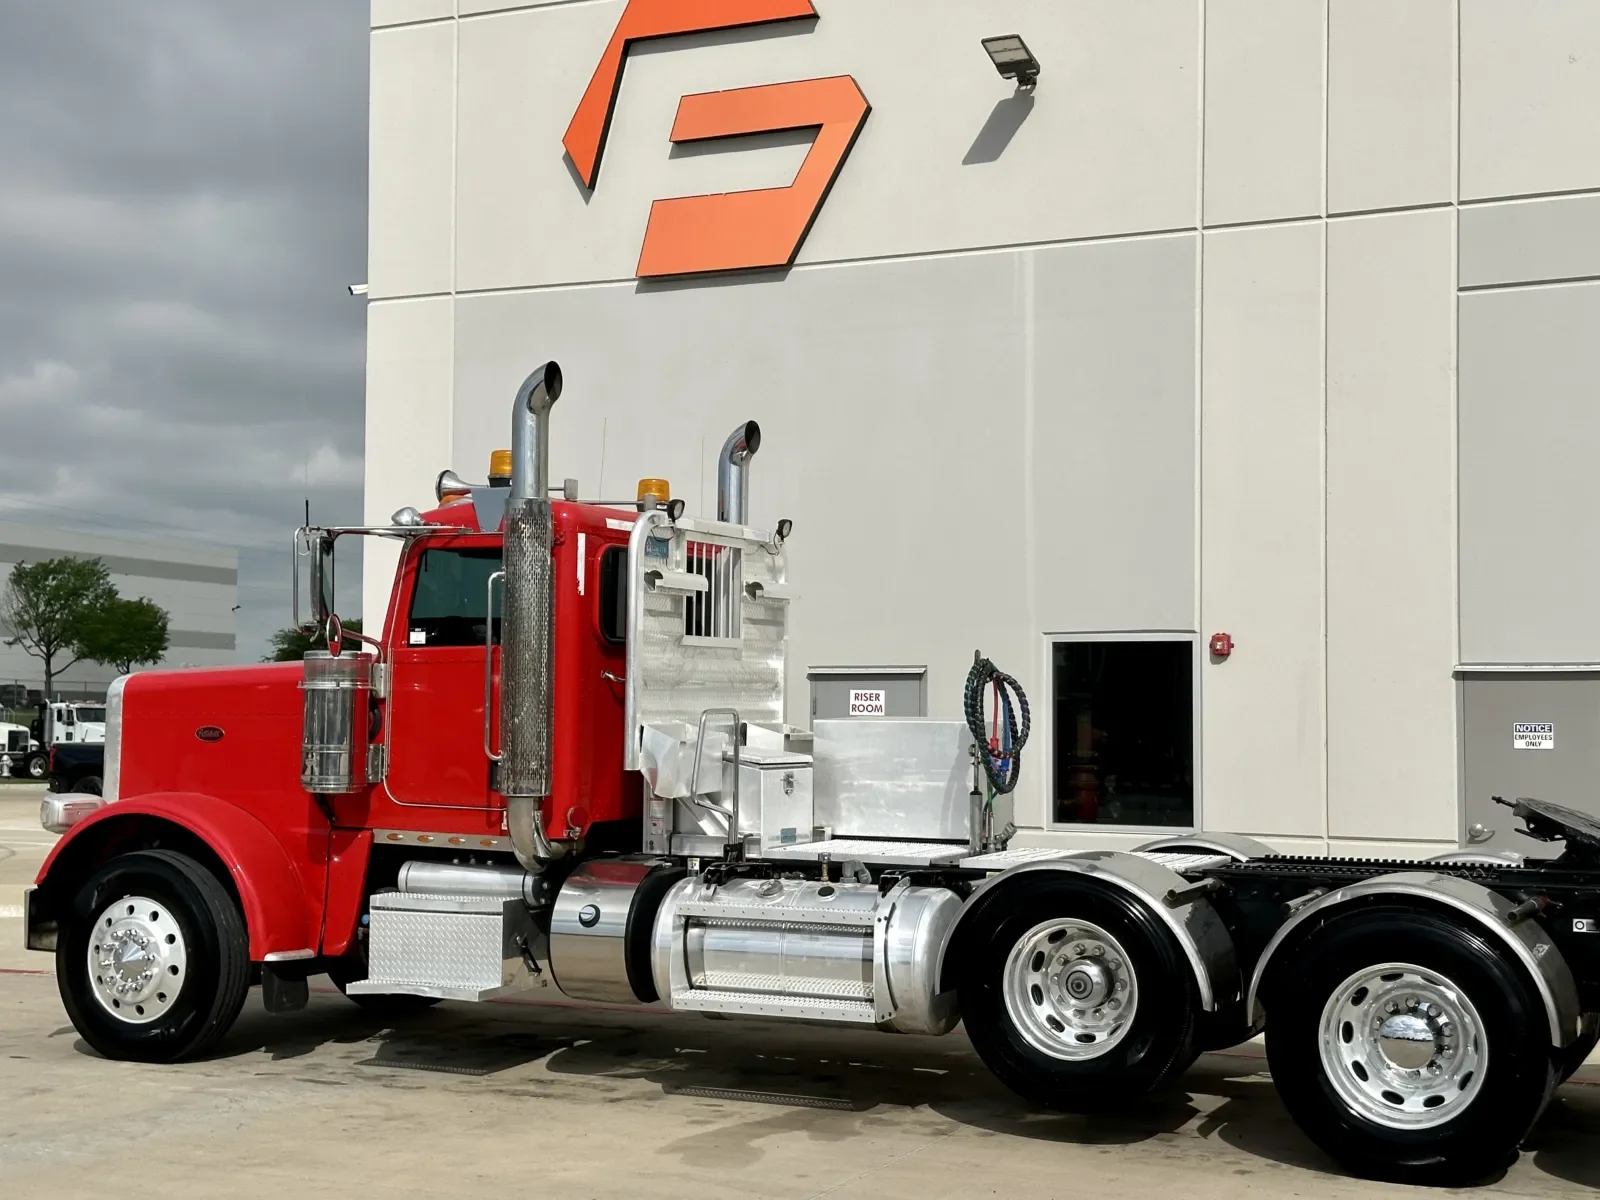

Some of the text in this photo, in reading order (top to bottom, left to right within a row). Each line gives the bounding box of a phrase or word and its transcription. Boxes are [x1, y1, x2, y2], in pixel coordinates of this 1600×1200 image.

[854, 692, 881, 701] RISER
[851, 703, 883, 713] ROOM
[1516, 724, 1551, 732] NOTICE
